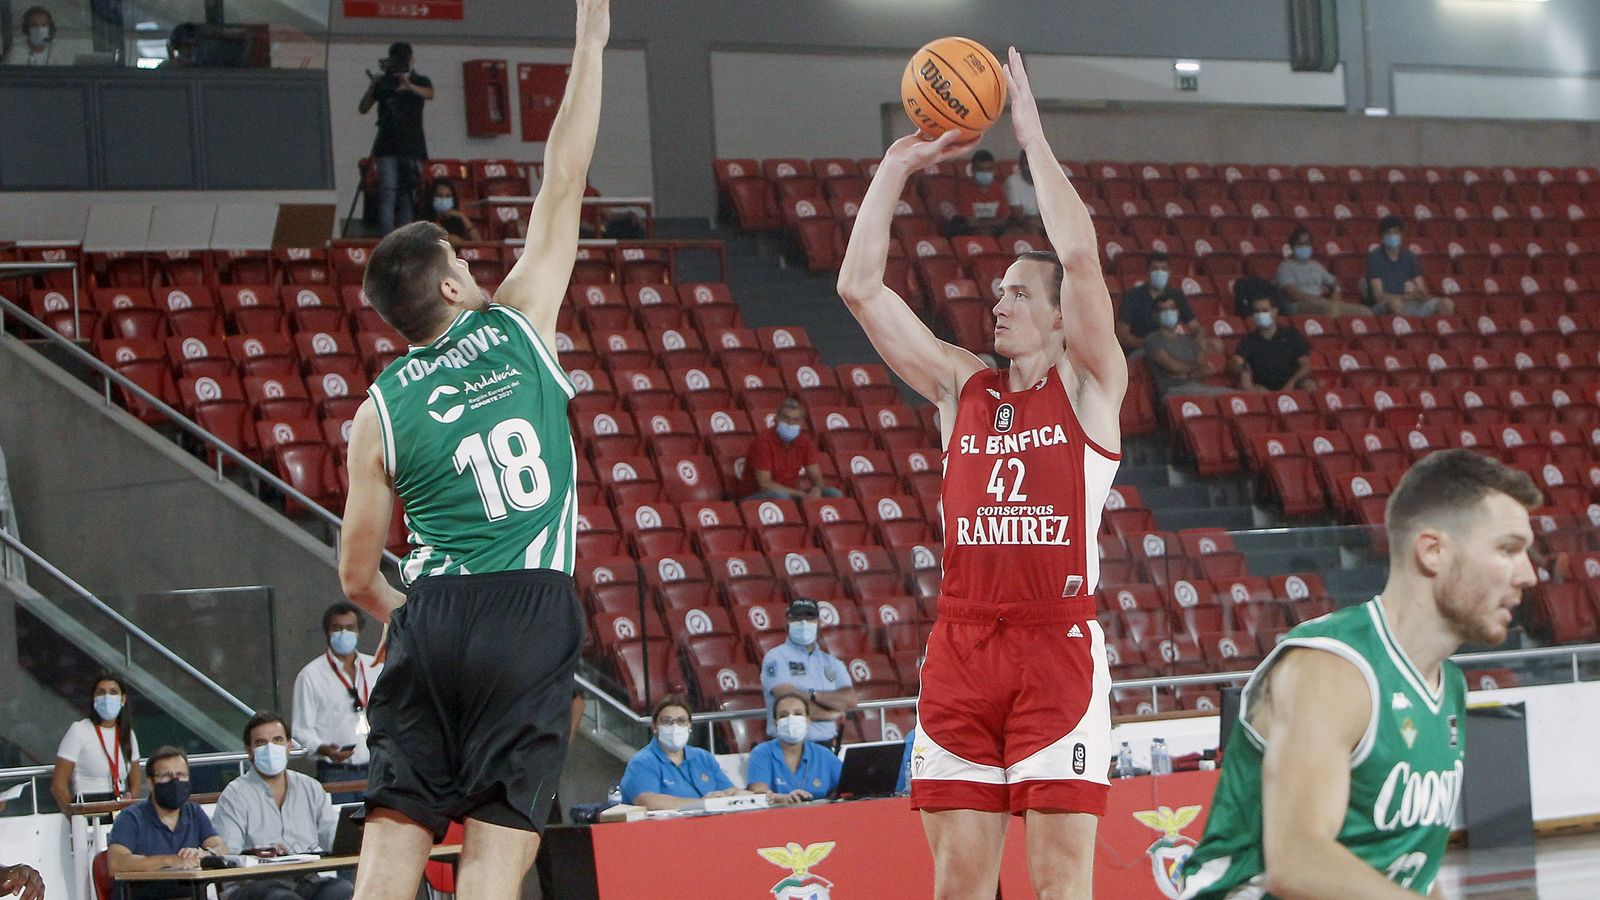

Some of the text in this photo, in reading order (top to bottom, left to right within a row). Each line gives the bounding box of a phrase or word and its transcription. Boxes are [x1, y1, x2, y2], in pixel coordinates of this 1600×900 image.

[919, 58, 970, 120] Wilson
[463, 364, 522, 395] Andalucía
[470, 389, 513, 410] DEPORTE 2021
[960, 435, 980, 454] SL
[452, 418, 551, 522] 18
[986, 457, 1028, 502] 42
[976, 504, 1054, 516] conservas
[957, 515, 1070, 545] RAMIREZ
